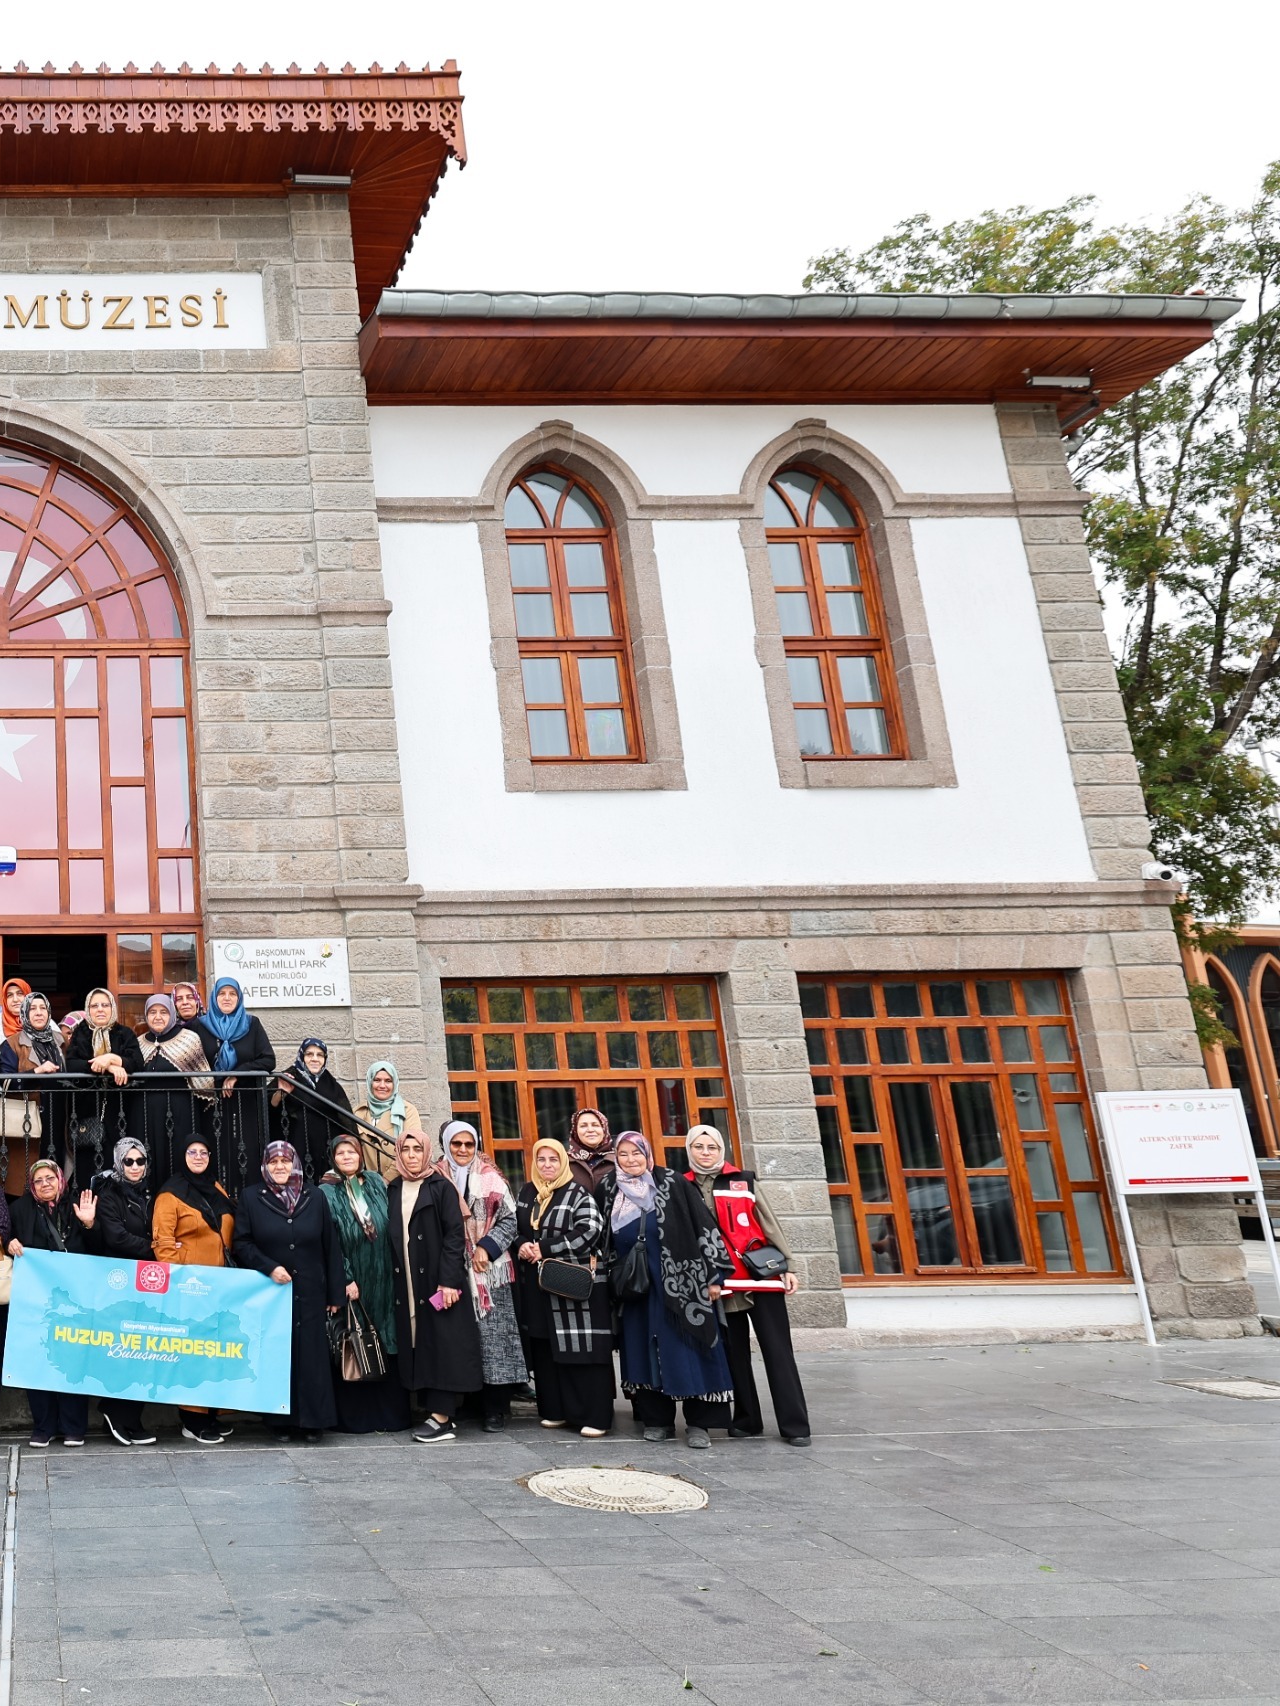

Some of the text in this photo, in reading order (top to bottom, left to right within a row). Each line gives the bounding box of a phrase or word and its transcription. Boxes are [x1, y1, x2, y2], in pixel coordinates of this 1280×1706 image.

[3, 287, 230, 330] MÜZESİ
[255, 949, 305, 957] BAŞKOMUTAN
[238, 959, 327, 969] TARİHİ MİLLİ PARK
[258, 971, 308, 980] MÜDÜRLÜĞÜ
[243, 983, 336, 997] AFER MÜZESİ
[1139, 1134, 1221, 1143] ALTERNATİF TURİZMDE
[54, 1325, 244, 1359] HUZUR VE KARDEŞLİK
[107, 1343, 180, 1363] Buluşması
